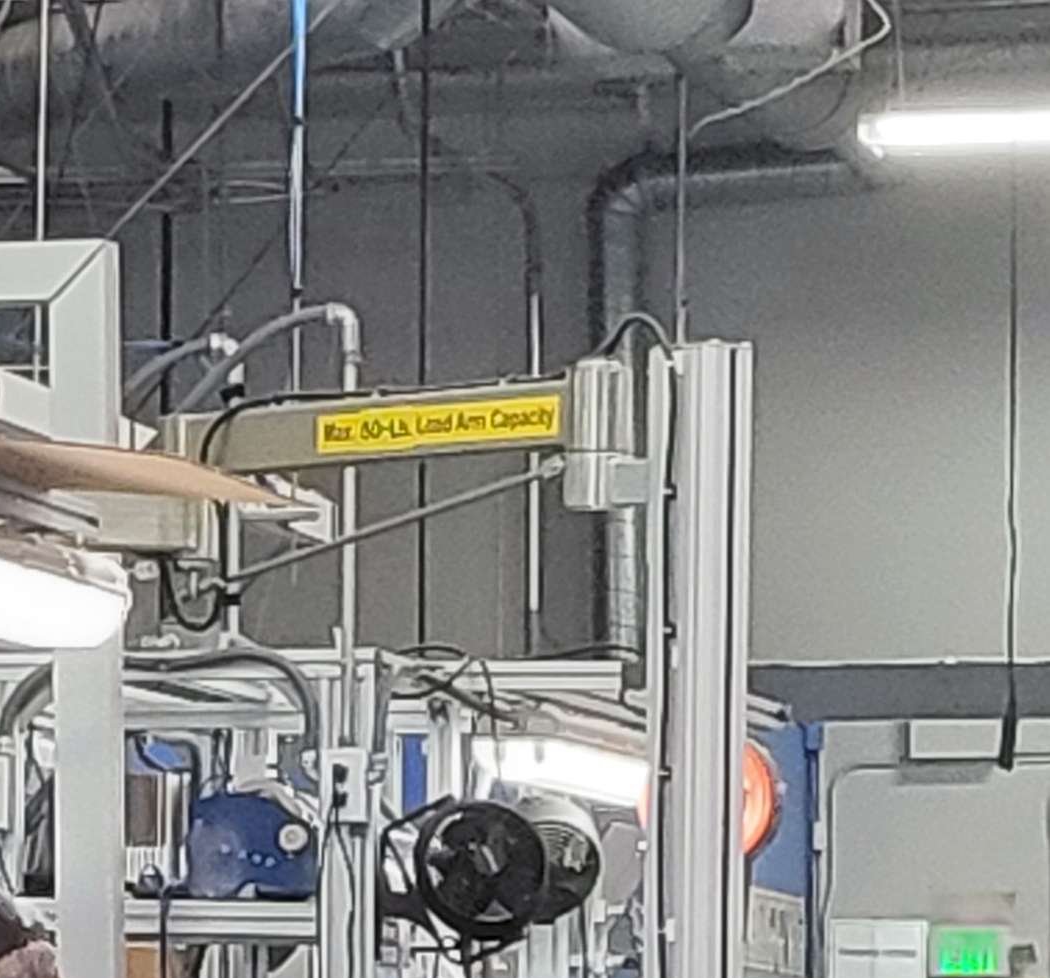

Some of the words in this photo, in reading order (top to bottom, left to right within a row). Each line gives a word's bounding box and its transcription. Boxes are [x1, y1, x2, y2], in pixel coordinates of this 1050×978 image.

[416, 412, 452, 434] Load
[455, 411, 486, 431] Arm
[491, 406, 555, 431] Capacity
